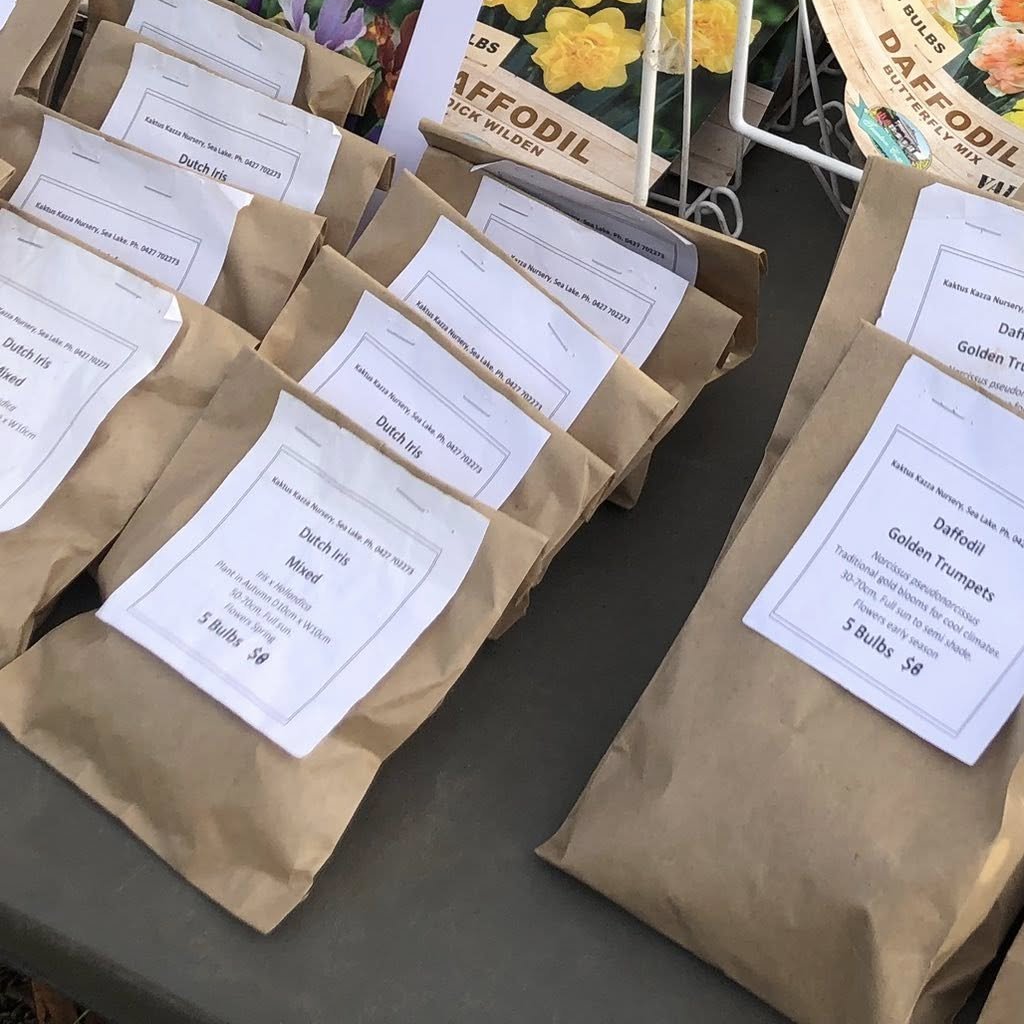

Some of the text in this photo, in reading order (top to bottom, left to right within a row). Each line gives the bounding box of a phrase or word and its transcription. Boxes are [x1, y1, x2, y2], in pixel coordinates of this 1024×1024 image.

[902, 4, 946, 54] BULBS
[452, 70, 594, 166] AFFODIL
[878, 28, 1020, 168] DAFFODIL
[882, 65, 956, 142] BUTTERFLY
[953, 142, 983, 166] MIX
[484, 118, 544, 158] WILDEN
[178, 154, 228, 182] Dutch Iris
[2, 337, 52, 370] Dutch Iris
[957, 340, 1004, 366] Golden
[376, 414, 424, 460] Dutch Iris
[890, 458, 915, 479] Kaktus
[914, 472, 935, 492] Kazza
[936, 486, 965, 512] Nursery,
[965, 505, 980, 520] Sea
[998, 525, 1012, 541] Ph.
[298, 526, 352, 568] Dutch Iris
[933, 516, 986, 558] Daffodil
[284, 555, 324, 585] Mixed
[871, 550, 981, 626] Narcissus pseudonarcissus
[888, 526, 996, 603] Golden Trumpets
[214, 560, 236, 578] Plant
[234, 574, 242, 583] in
[242, 579, 272, 603] Autumn
[271, 598, 298, 620] D10cm
[303, 620, 332, 644] W10cm
[256, 570, 270, 582] Iris
[273, 582, 312, 612] Hollandica
[834, 544, 1000, 658] Traditional gold blooms for cool climates.
[198, 611, 212, 626] 5
[208, 618, 244, 648] Bulbs
[224, 602, 276, 644] Flowers Spring
[262, 612, 280, 625] Full
[854, 598, 939, 660] Flowers early season
[878, 594, 896, 610] Full
[896, 607, 912, 622] sun
[910, 614, 922, 628] to
[922, 622, 945, 644] semi
[842, 616, 924, 676] 5 Bulbs $8
